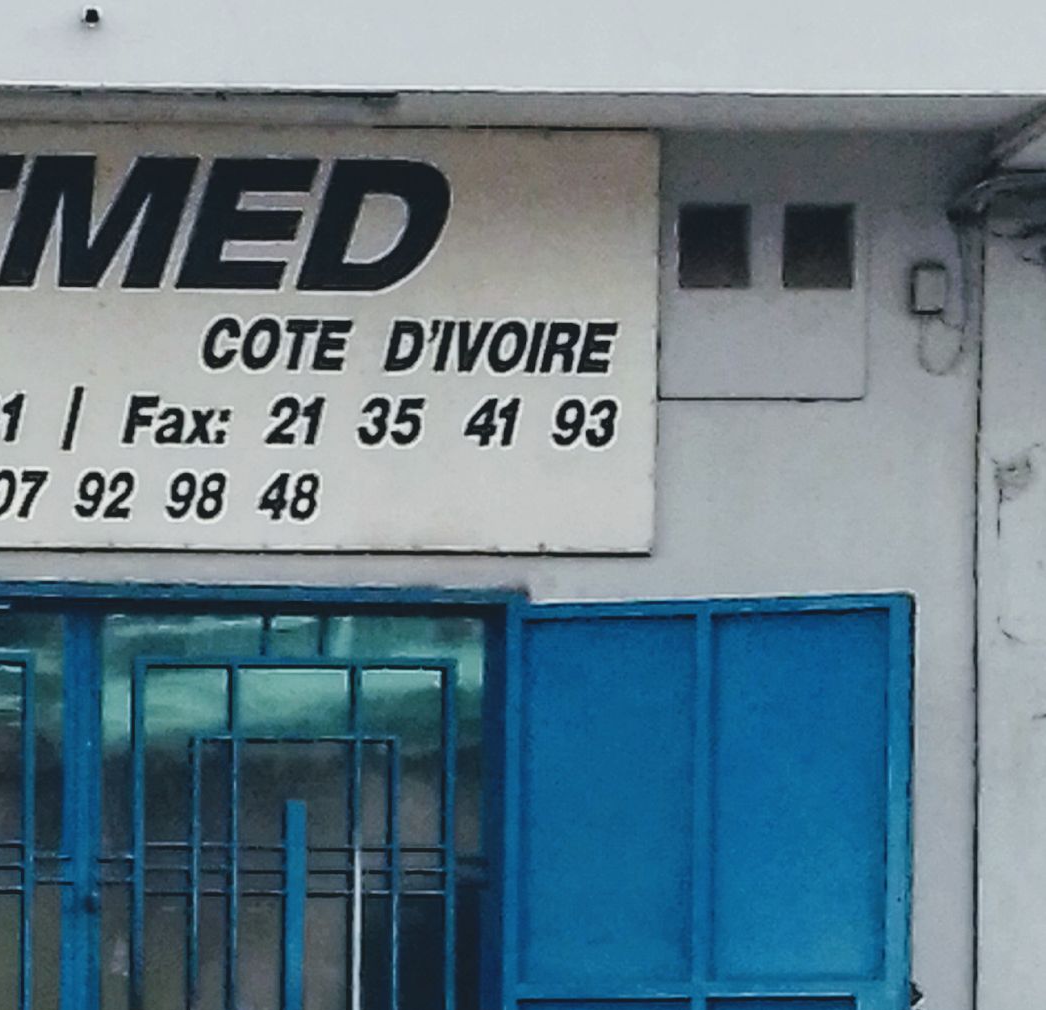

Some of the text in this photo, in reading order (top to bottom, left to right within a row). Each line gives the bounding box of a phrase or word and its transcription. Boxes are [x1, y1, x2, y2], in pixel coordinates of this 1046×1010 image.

[202, 317, 619, 374] COTE D'IVOIRE
[121, 395, 232, 445] Fax:
[264, 396, 326, 445] 21
[357, 397, 426, 446] 35
[463, 397, 521, 447] 41
[551, 399, 618, 448] 93
[74, 471, 135, 519] 92
[165, 472, 227, 520] 98
[258, 472, 320, 521] 48
